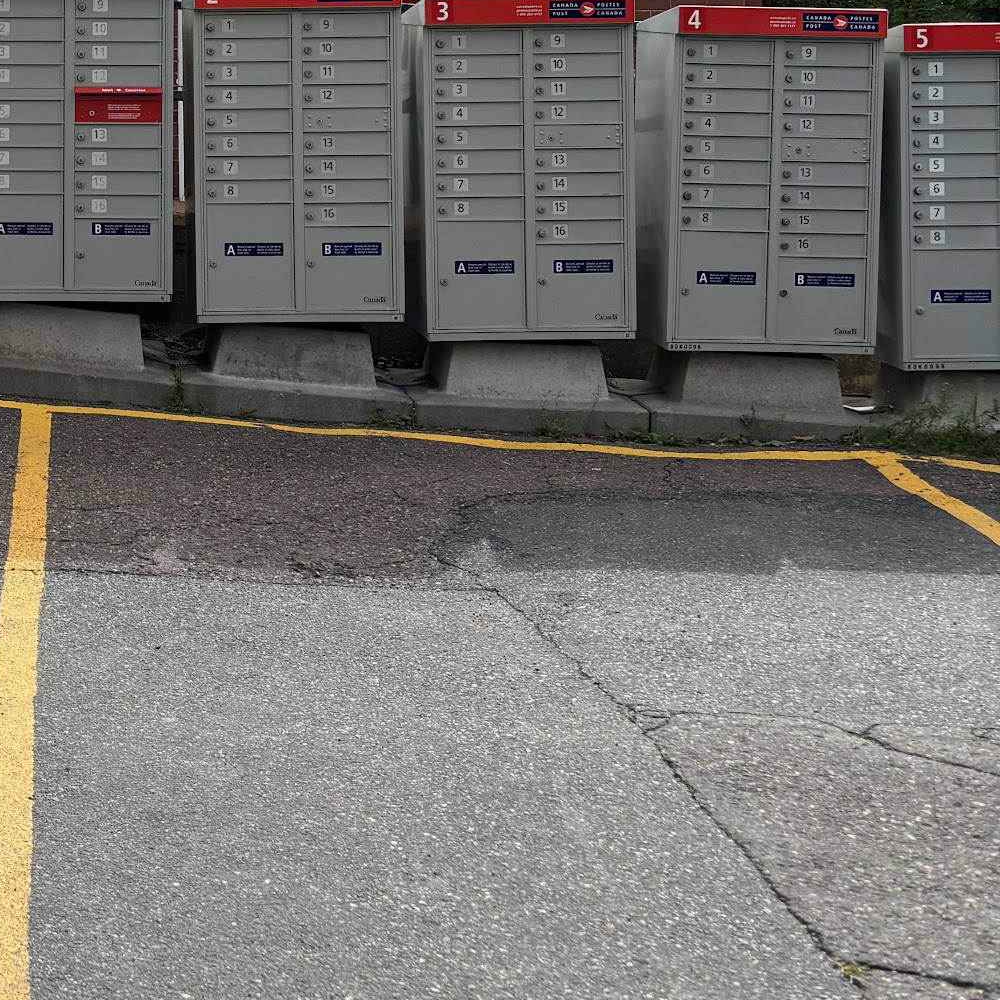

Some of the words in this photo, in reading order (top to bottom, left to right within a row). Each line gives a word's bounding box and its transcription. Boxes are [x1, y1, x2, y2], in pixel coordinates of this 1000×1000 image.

[97, 0, 104, 9] 9
[436, 1, 449, 22] 3
[323, 19, 330, 29] 9
[687, 9, 702, 29] 4
[0, 23, 5, 32] 2
[94, 23, 106, 33] 10
[554, 35, 561, 45] 9
[916, 28, 928, 48] 5
[0, 47, 5, 57] 3
[94, 47, 106, 56] 11
[226, 44, 232, 54] 2
[322, 43, 332, 52] 10
[805, 48, 812, 58] 9
[456, 60, 462, 70] 2
[552, 59, 563, 69] 10
[94, 70, 106, 80] 12
[226, 67, 232, 77] 3
[322, 67, 332, 76] 11
[706, 70, 713, 80] 2
[803, 72, 814, 82] 10
[456, 84, 463, 94] 3
[554, 83, 563, 93] 11
[932, 88, 939, 98] 2
[226, 91, 232, 100] 4
[322, 90, 332, 100] 12
[706, 94, 712, 104] 3
[803, 96, 812, 106] 11
[0, 105, 6, 115] 5
[456, 108, 463, 117] 4
[554, 107, 564, 117] 12
[226, 115, 233, 124] 5
[933, 112, 939, 122] 3
[704, 118, 712, 127] 4
[802, 119, 812, 129] 12
[94, 130, 105, 139] 13
[457, 132, 463, 142] 5
[227, 138, 233, 148] 6
[323, 138, 333, 147] 13
[932, 136, 940, 145] 4
[704, 142, 711, 152] 5
[0, 152, 5, 162] 7
[94, 153, 106, 163] 14
[457, 156, 464, 166] 6
[554, 154, 565, 164] 13
[228, 162, 234, 172] 7
[323, 162, 333, 171] 14
[933, 160, 940, 170] 5
[704, 166, 710, 175] 6
[800, 168, 811, 178] 13
[94, 177, 106, 187] 15
[458, 179, 464, 189] 7
[554, 178, 565, 188] 14
[227, 186, 234, 195] 8
[323, 185, 334, 195] 15
[703, 189, 710, 198] 7
[933, 184, 940, 194] 6
[800, 191, 810, 200] 14
[94, 200, 106, 210] 16
[458, 203, 464, 213] 8
[554, 202, 566, 212] 15
[323, 208, 335, 218] 16
[702, 213, 709, 223] 8
[934, 208, 940, 218] 7
[799, 215, 810, 225] 15
[94, 223, 102, 234] B
[555, 226, 566, 236] 16
[934, 232, 941, 242] 8
[798, 239, 809, 249] 16
[226, 244, 236, 255] A
[324, 244, 331, 255] B
[457, 262, 466, 273] A
[556, 262, 563, 272] B
[698, 272, 708, 284] A
[797, 274, 805, 285] B
[933, 291, 942, 302] A
